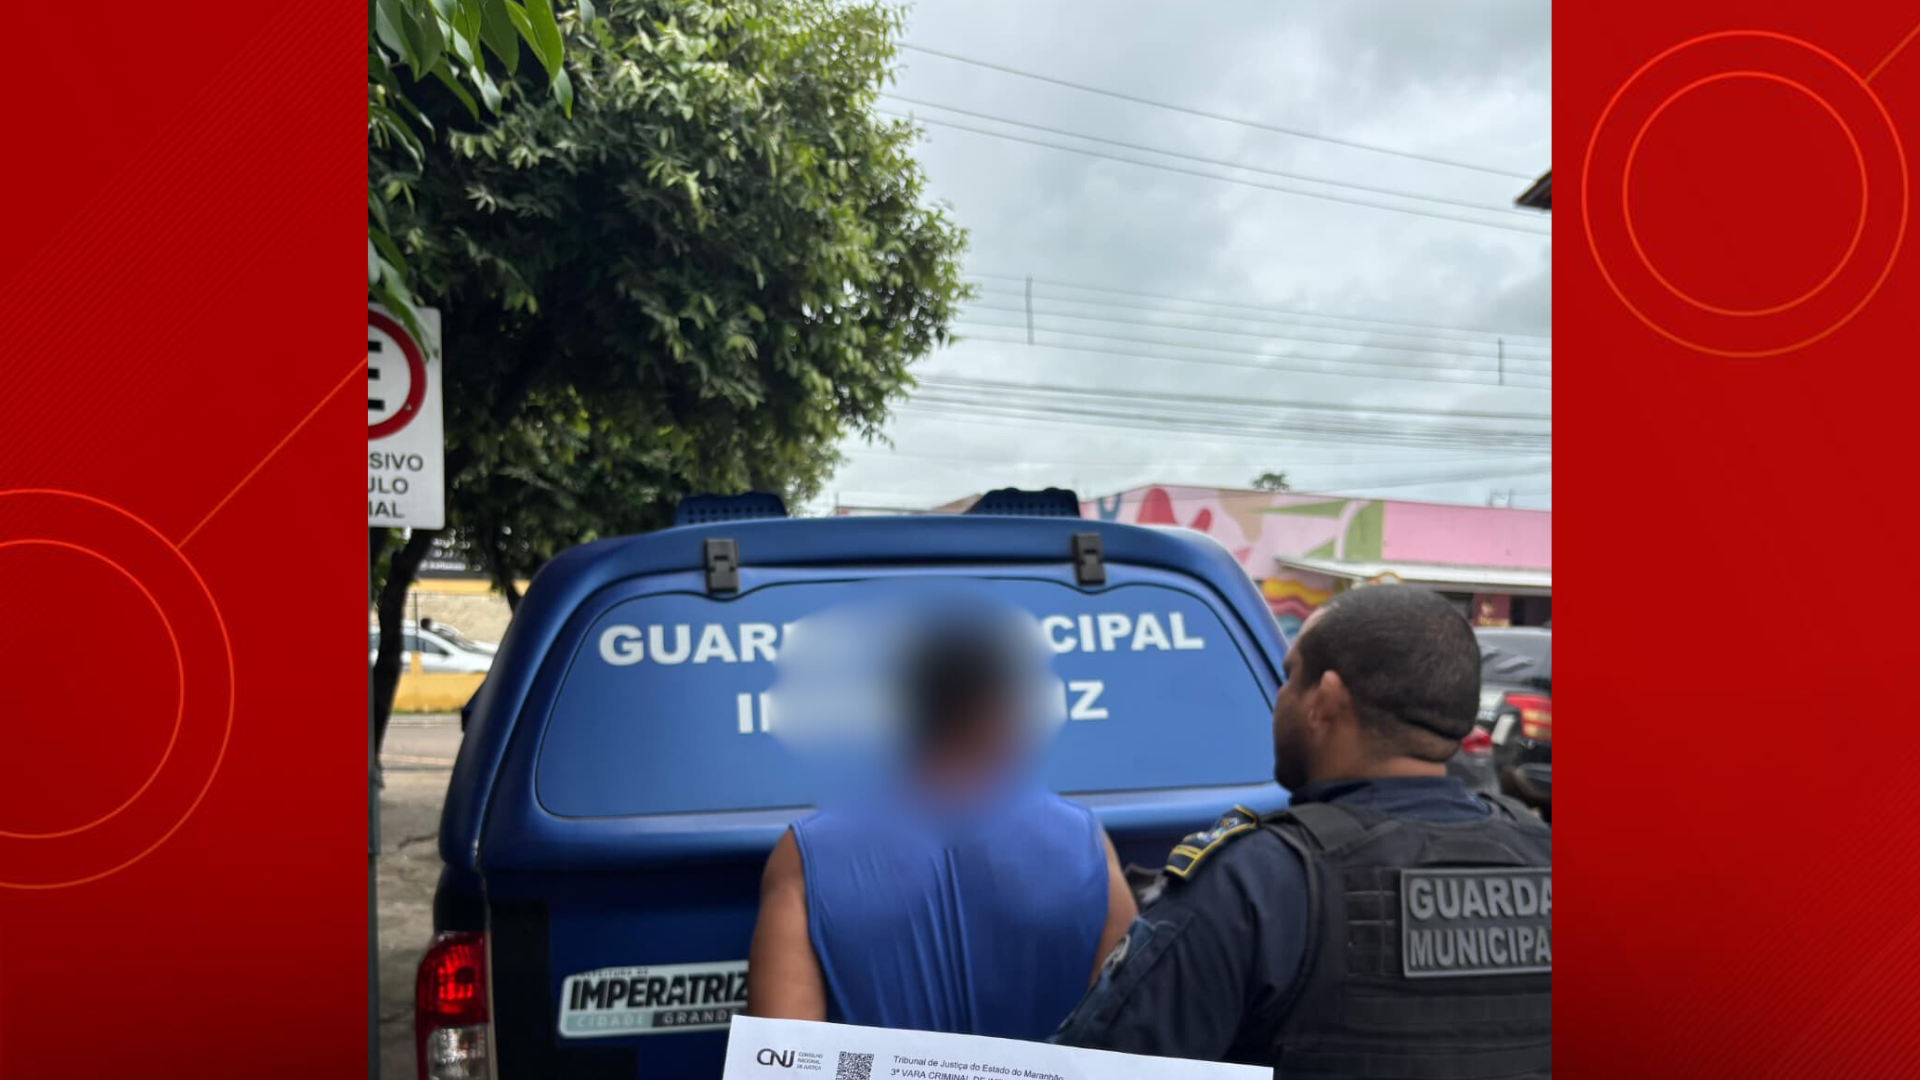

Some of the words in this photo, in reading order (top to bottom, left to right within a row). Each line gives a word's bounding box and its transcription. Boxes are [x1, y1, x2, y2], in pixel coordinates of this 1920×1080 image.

[598, 621, 793, 666] GUAR
[1041, 612, 1205, 654] CIPAL
[1408, 926, 1552, 967] MUNICIPA
[569, 971, 749, 1011] IMPERATRIZ
[756, 1048, 795, 1068] CNJ
[893, 1055, 927, 1066] Tribunal
[927, 1059, 938, 1067] de
[940, 1060, 968, 1070] Justiça
[970, 1063, 981, 1071] do
[982, 1064, 1010, 1075] Estado
[1011, 1067, 1022, 1077] do
[901, 1069, 926, 1079] VARA
